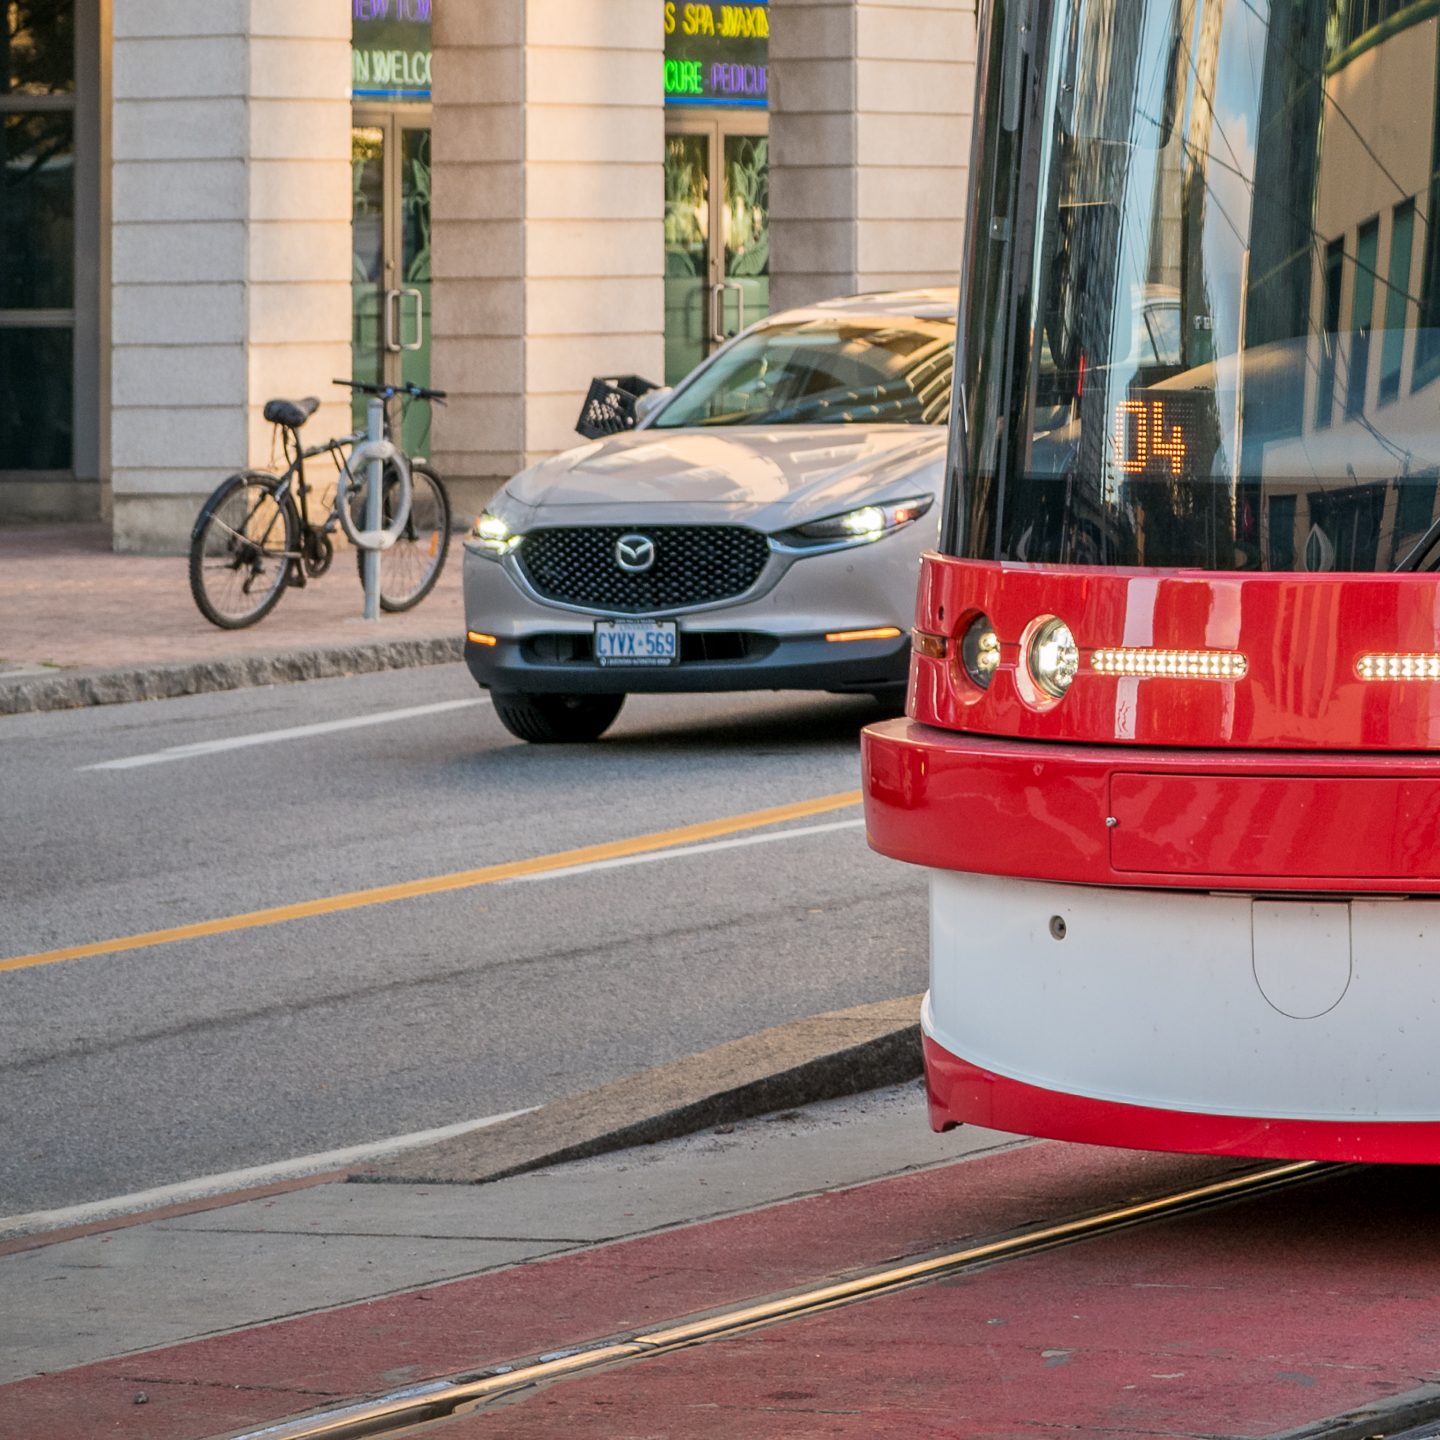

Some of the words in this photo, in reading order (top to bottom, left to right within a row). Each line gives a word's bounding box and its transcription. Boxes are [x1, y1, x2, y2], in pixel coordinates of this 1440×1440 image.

[683, 3, 715, 36] SPA
[665, 60, 703, 94] CURE
[1115, 400, 1186, 474] 04
[598, 632, 636, 655] CYVX
[645, 632, 675, 655] 569
